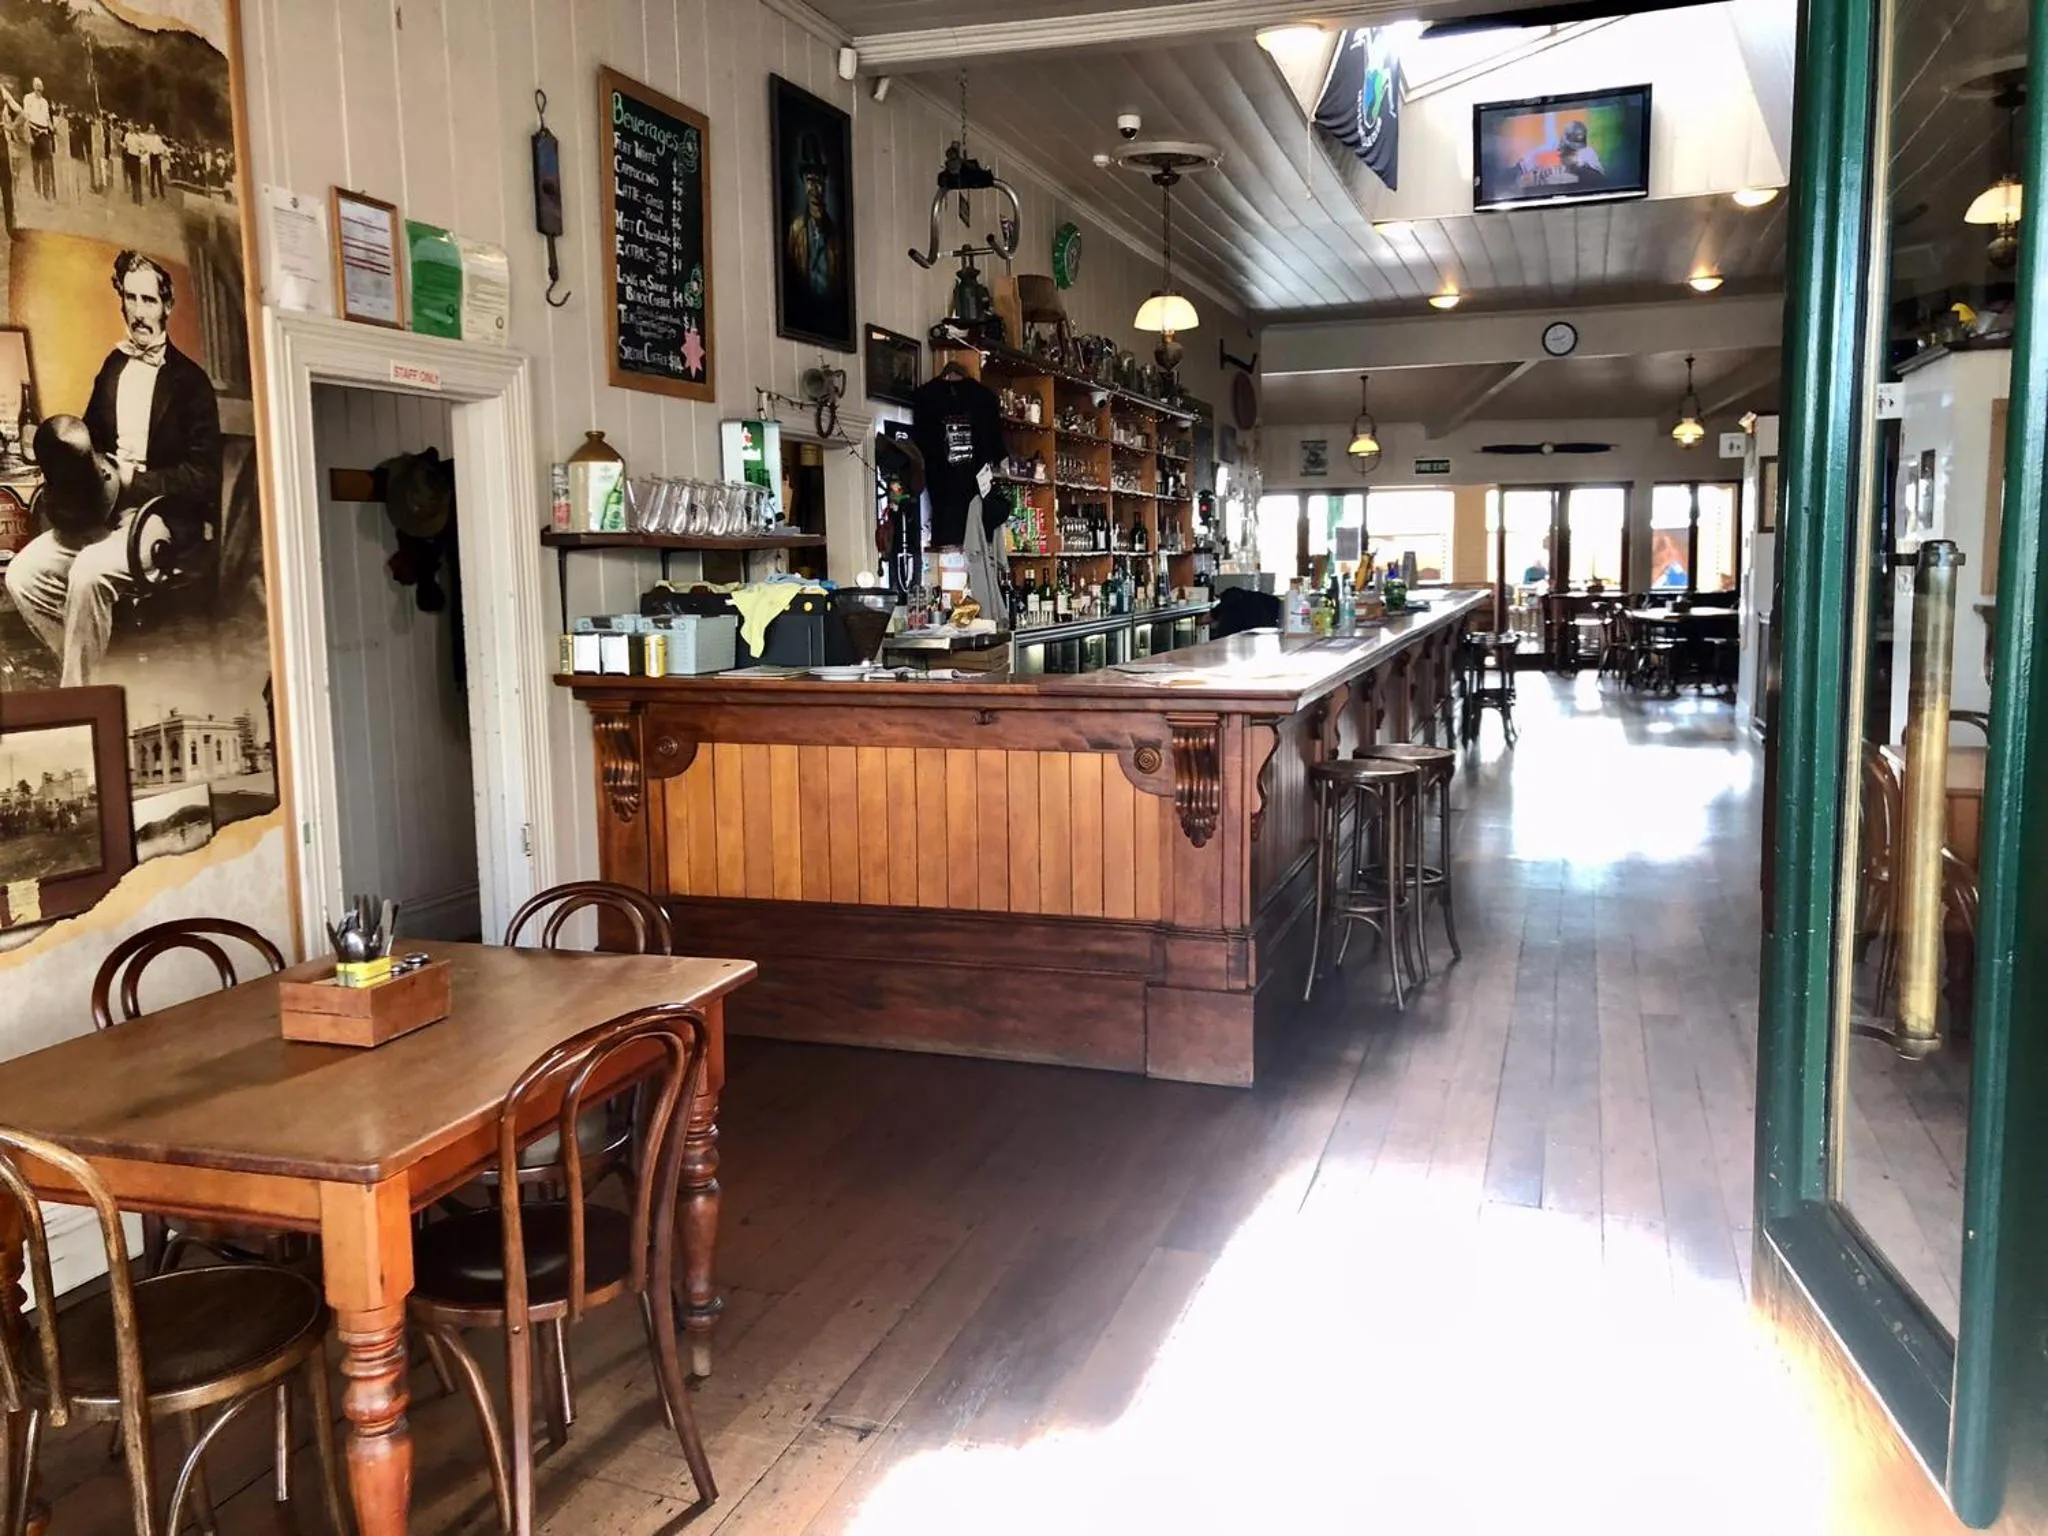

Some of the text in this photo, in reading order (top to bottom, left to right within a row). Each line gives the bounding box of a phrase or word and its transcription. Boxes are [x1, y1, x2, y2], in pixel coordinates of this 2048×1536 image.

[612, 92, 679, 157] Beverages
[672, 196, 682, 212] $5
[394, 365, 439, 385] STAFF ONLY
